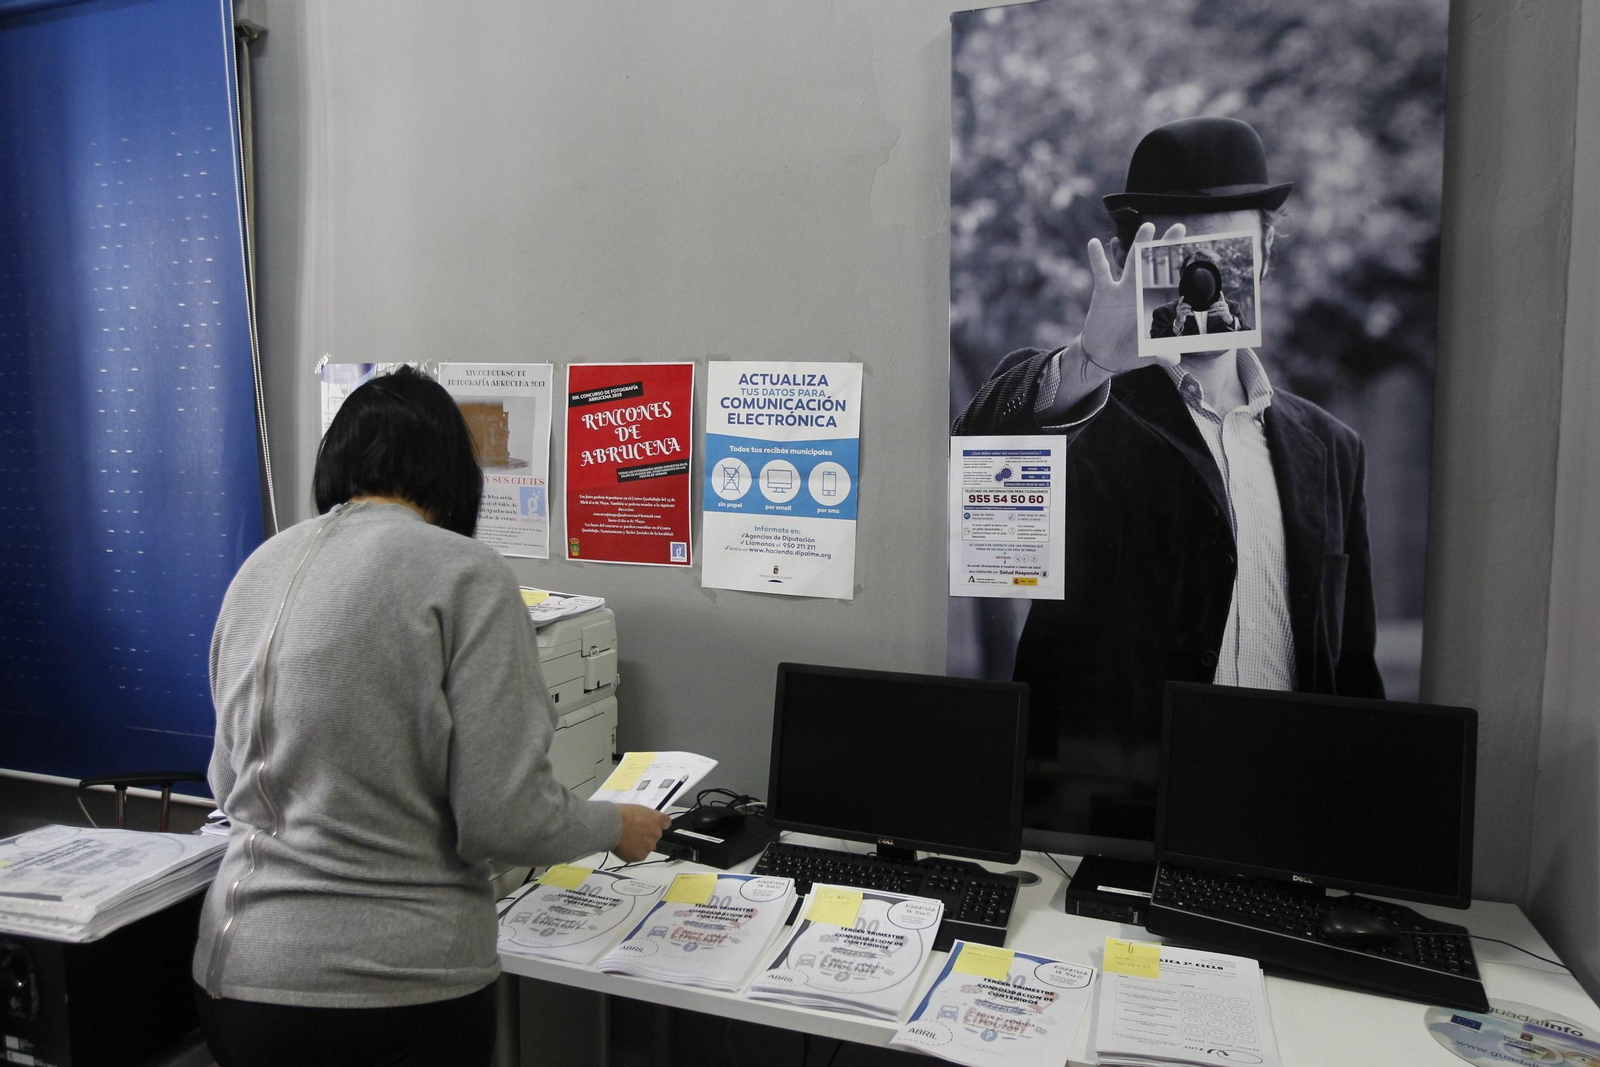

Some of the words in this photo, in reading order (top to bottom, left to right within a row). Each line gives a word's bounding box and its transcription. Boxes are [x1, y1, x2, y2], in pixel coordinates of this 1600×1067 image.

[738, 374, 829, 387] ACTUALIZA
[741, 388, 759, 396] TUS
[762, 388, 796, 397] DATOS
[798, 389, 826, 397] PARA
[721, 396, 846, 411] COMUNICACIÓN
[582, 401, 672, 430] RINCONES
[728, 411, 837, 427] ELECTRÓNICA
[615, 424, 641, 442] DE
[580, 437, 681, 466] ABRUCENA
[764, 446, 789, 455] recibos
[790, 448, 833, 456] municipales
[512, 477, 544, 485] GENTES
[969, 495, 990, 503] 955
[993, 495, 1008, 503] 54
[1011, 495, 1025, 503] 50
[1028, 495, 1044, 504] 60
[755, 525, 790, 534] Infórmate
[782, 535, 815, 544] Diputación
[749, 546, 832, 559] www.hacienda.dipalme.org
[1293, 875, 1313, 883] DELL
[835, 933, 892, 945] CONSOLIDACION
[867, 931, 904, 940] TRIMESTRE
[844, 940, 889, 949] CONTENIDOS
[768, 974, 794, 982] ABRIL
[978, 983, 1042, 1000] CONSOLIDACION
[984, 978, 1010, 986] TERCER
[1013, 984, 1055, 995] TRIMESTRE
[988, 991, 1038, 1005] CONTENIDOS
[1488, 1006, 1583, 1037] guadalinfo
[908, 1027, 937, 1040] ABRIL
